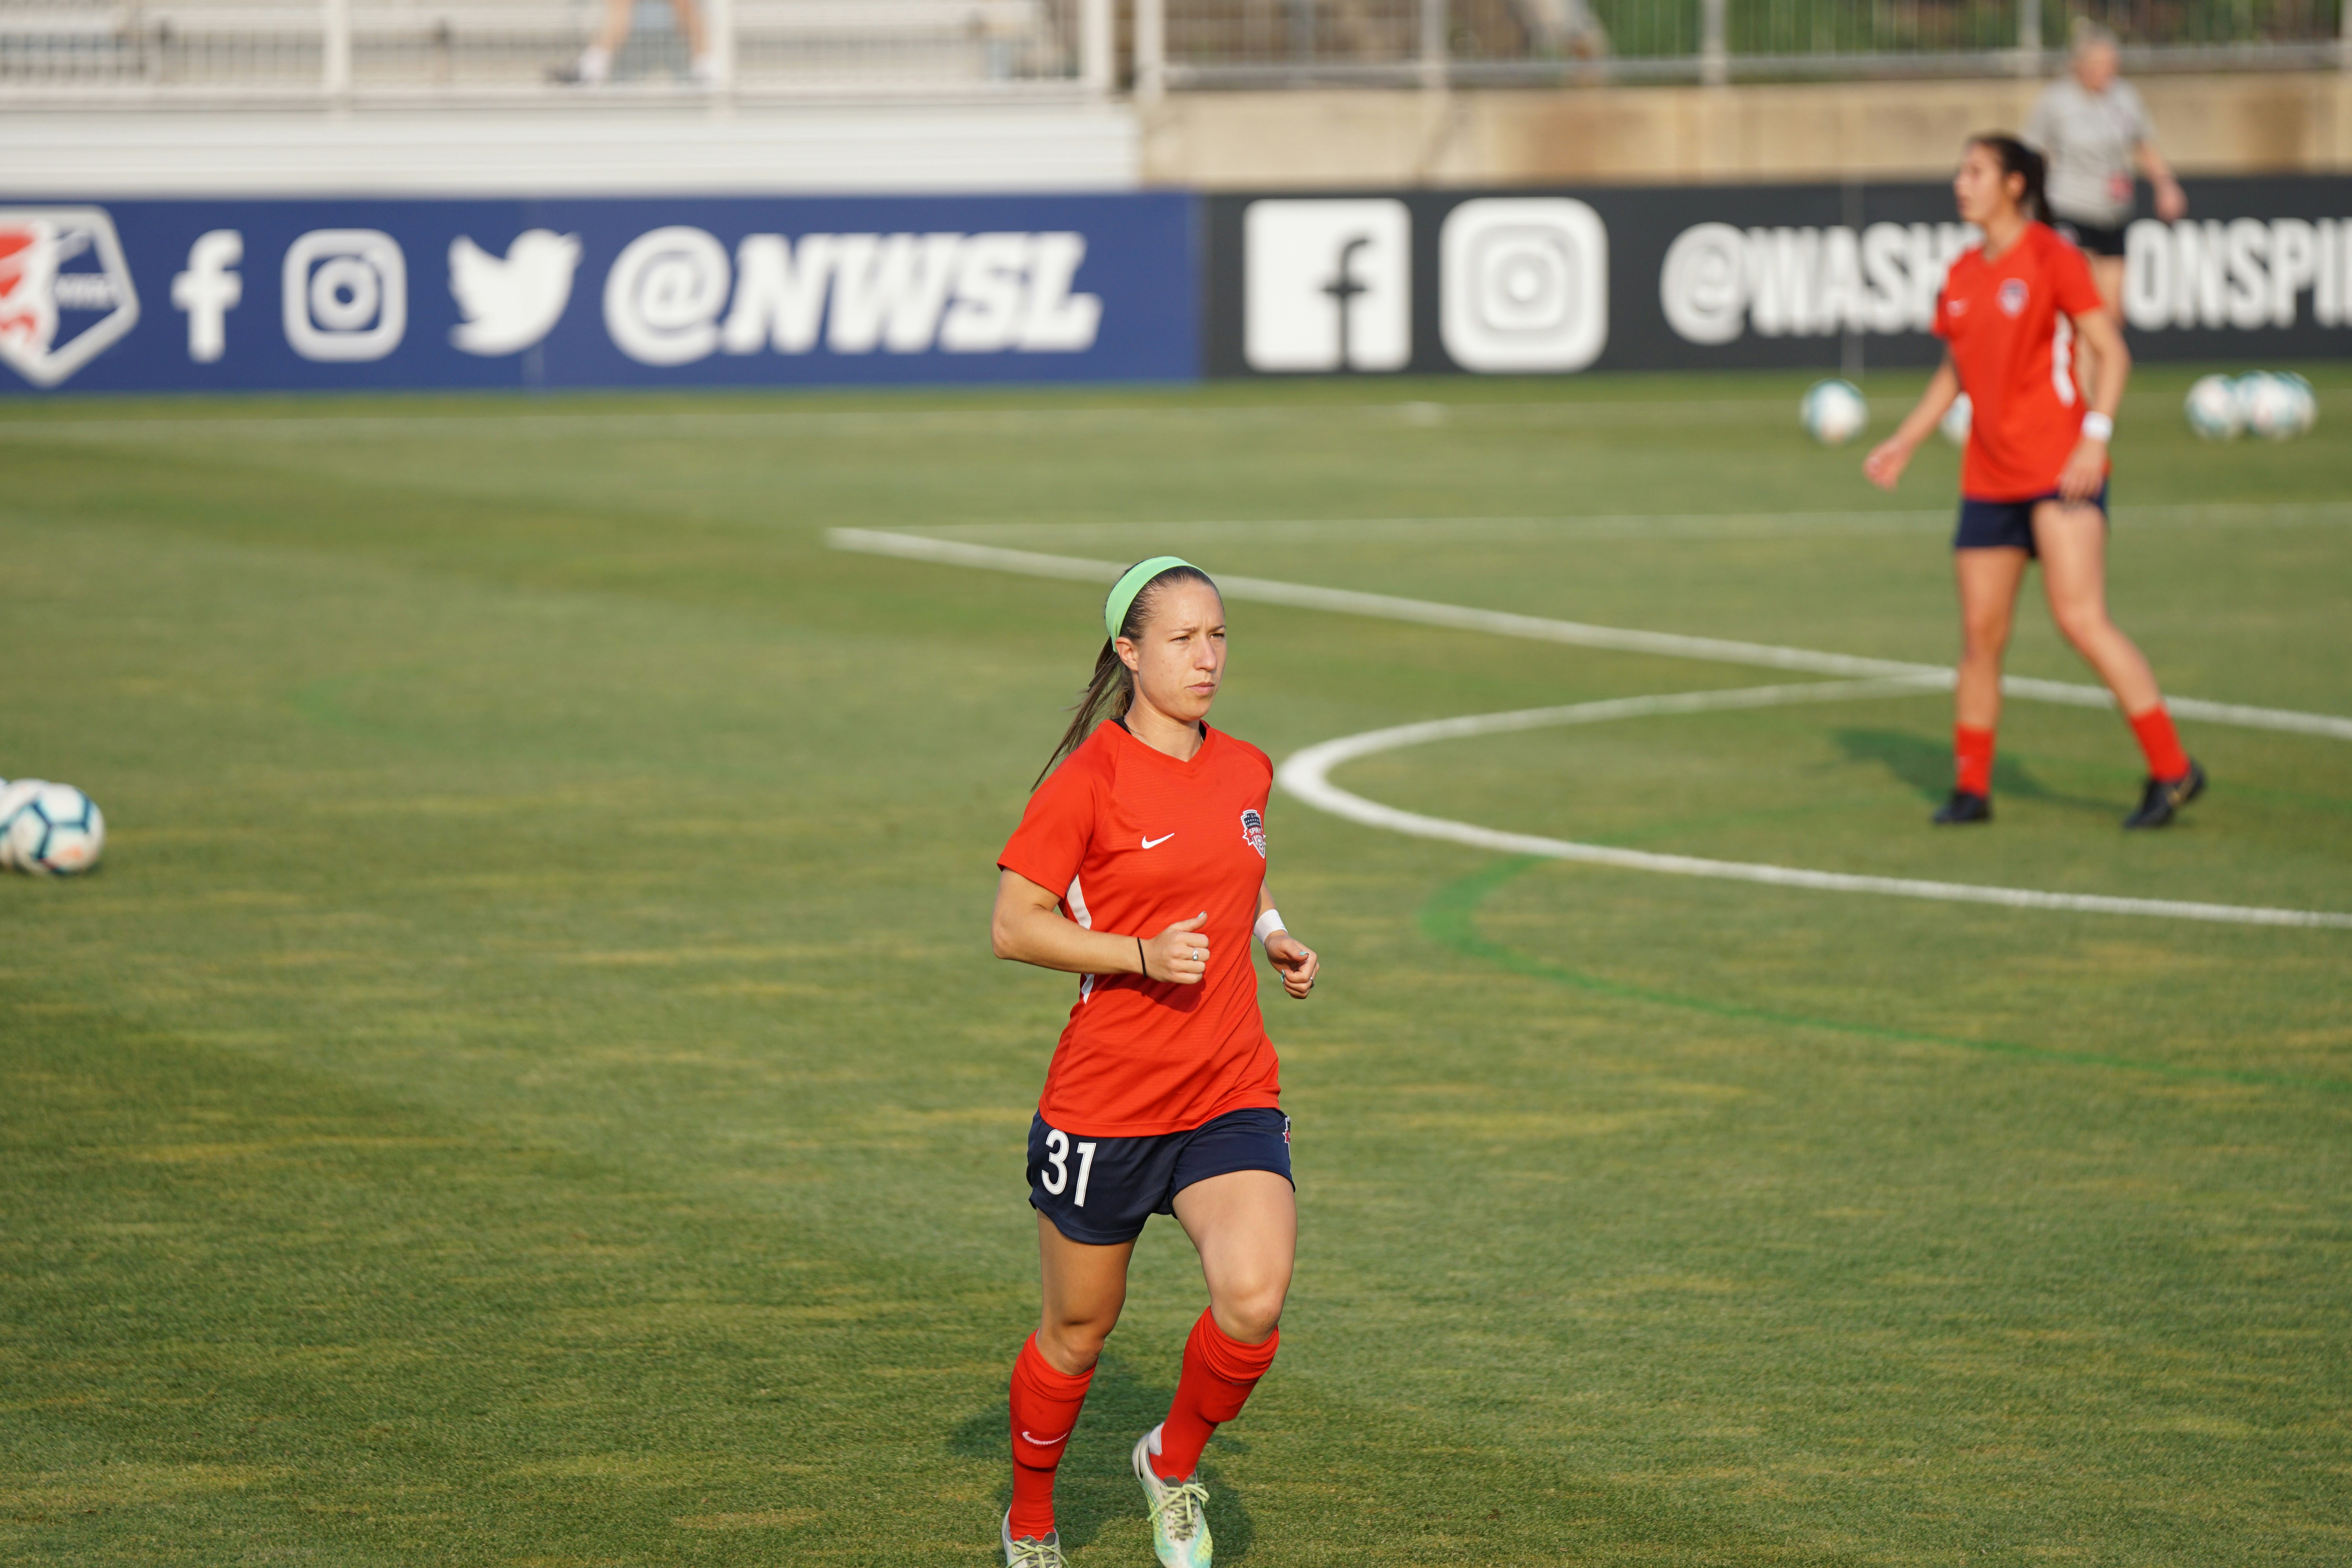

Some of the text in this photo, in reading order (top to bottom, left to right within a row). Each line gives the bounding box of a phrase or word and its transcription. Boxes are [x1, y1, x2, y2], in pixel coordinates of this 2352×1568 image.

[603, 225, 1102, 367] @NWSL
[1249, 827, 1261, 835] SPIRIT
[1041, 1129, 1096, 1207] 31
